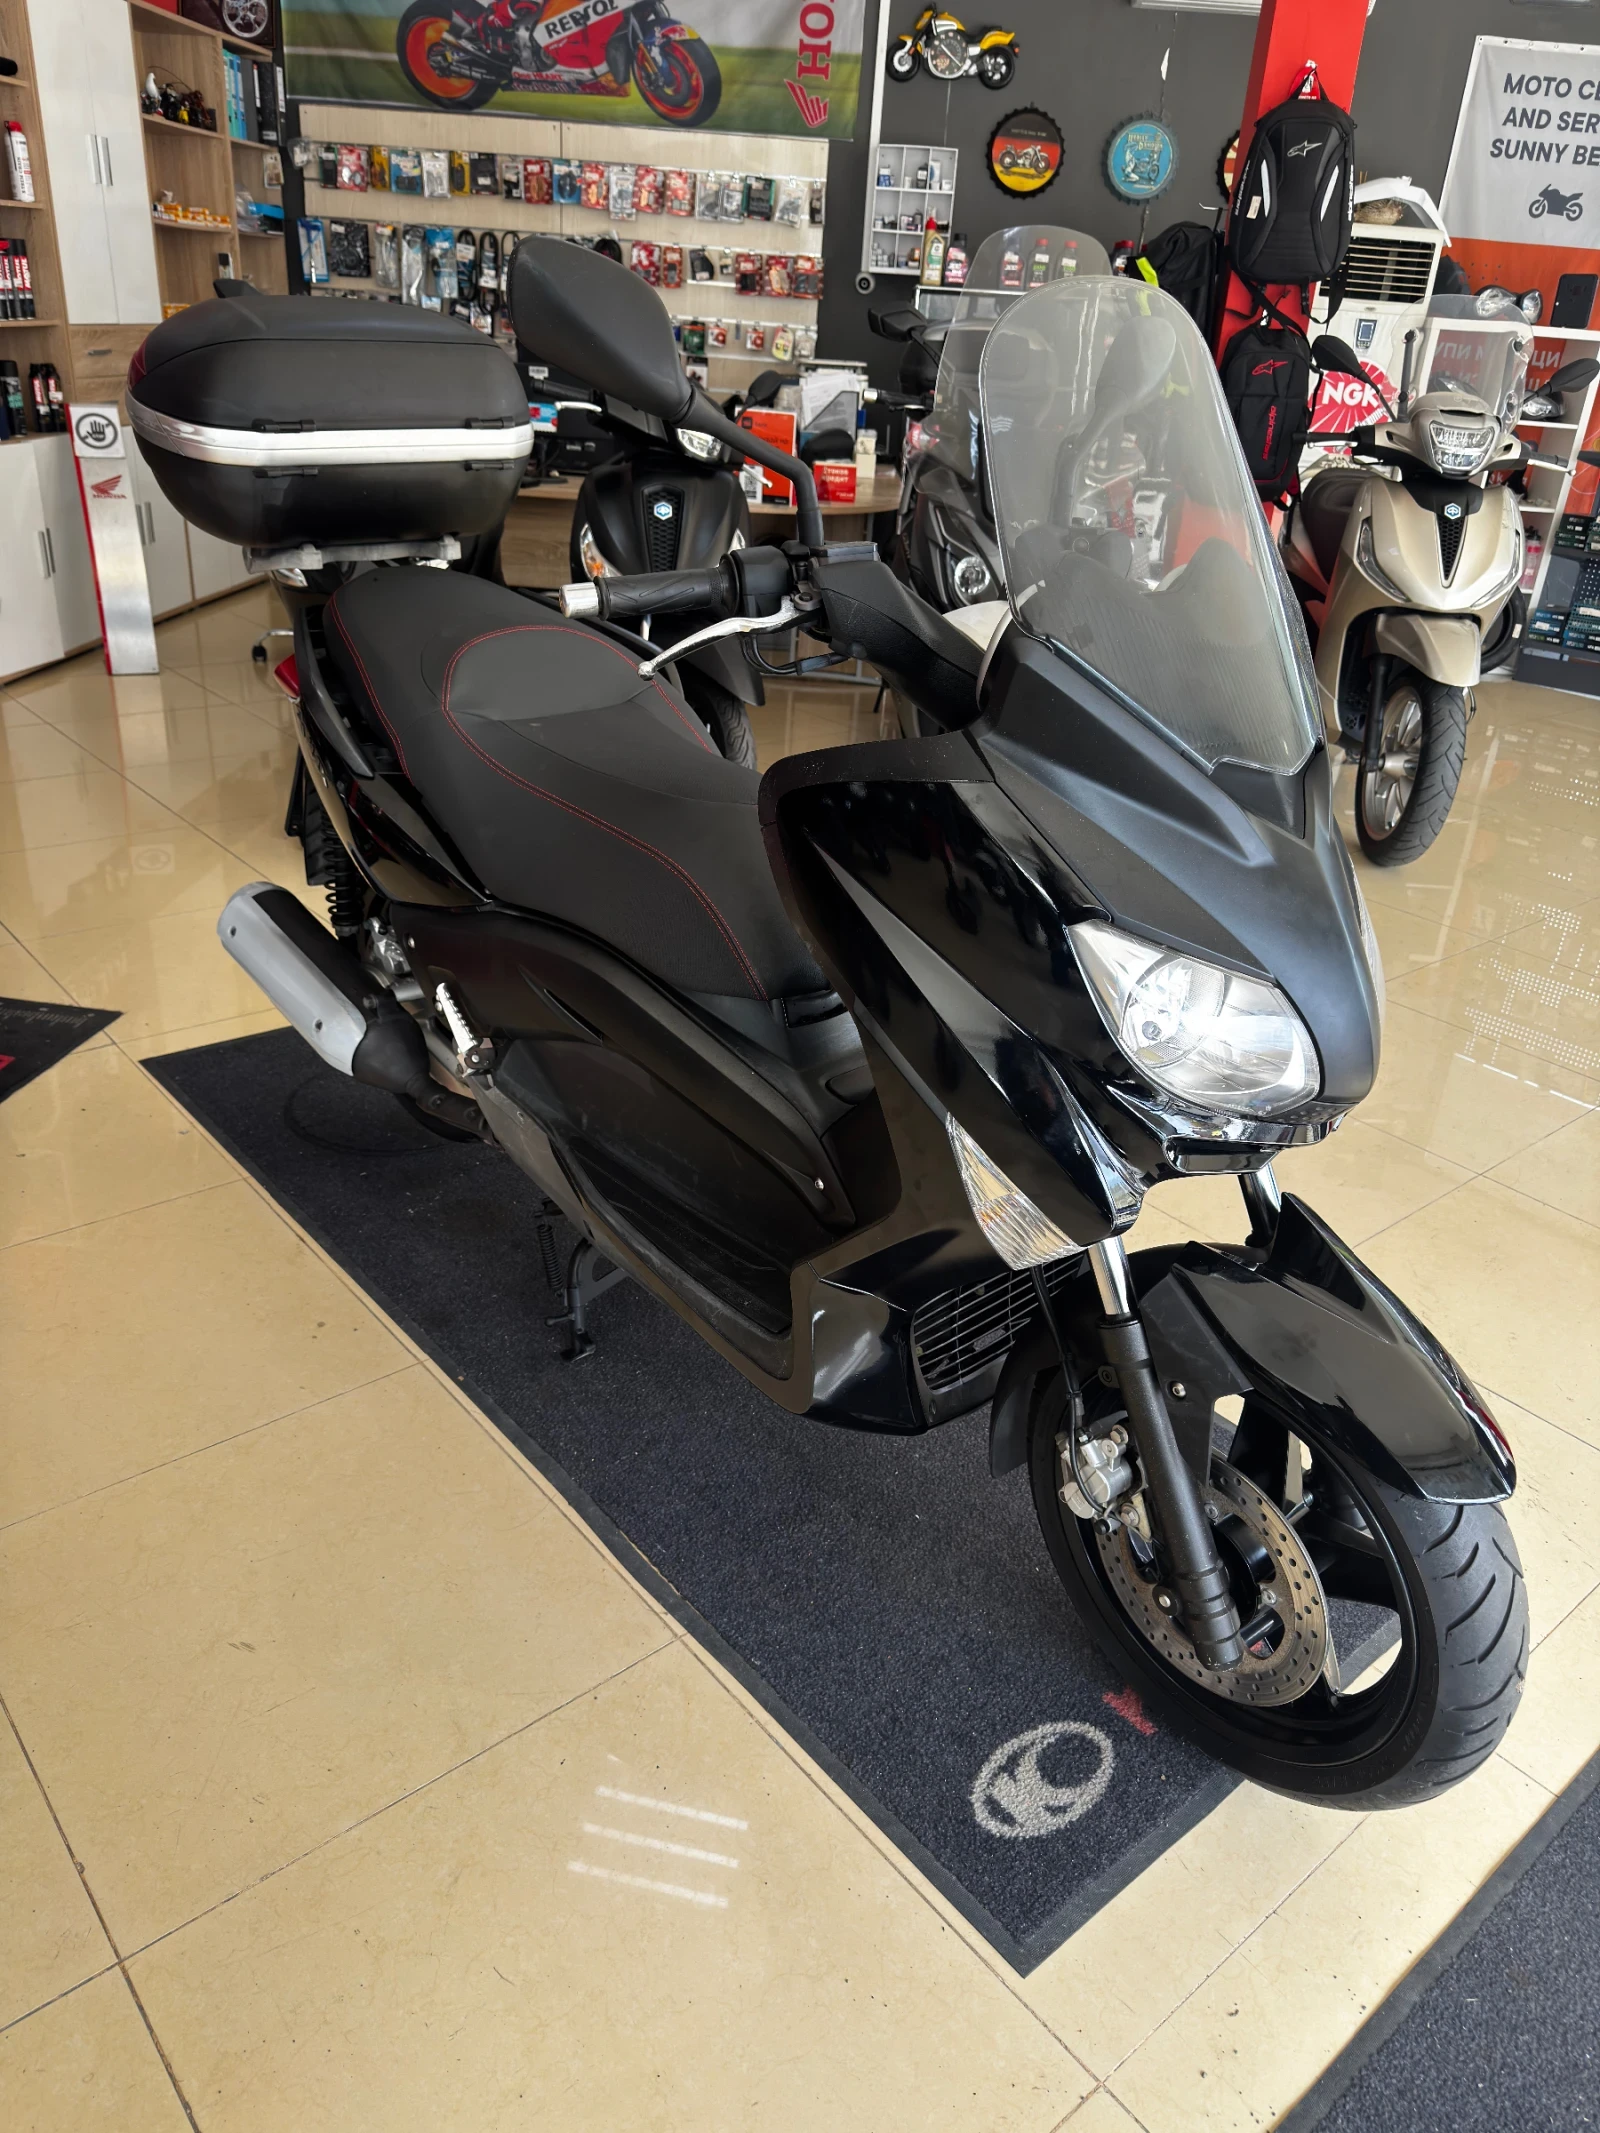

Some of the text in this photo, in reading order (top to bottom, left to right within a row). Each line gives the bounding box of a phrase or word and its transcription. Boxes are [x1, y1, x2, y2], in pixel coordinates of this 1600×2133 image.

[797, 0, 834, 81] HO
[1503, 72, 1573, 98] MOTO
[1502, 106, 1600, 134] AND SER
[1490, 138, 1600, 167] SUNNY BE
[21, 257, 32, 289] MOTUL
[1321, 381, 1383, 408] NGK
